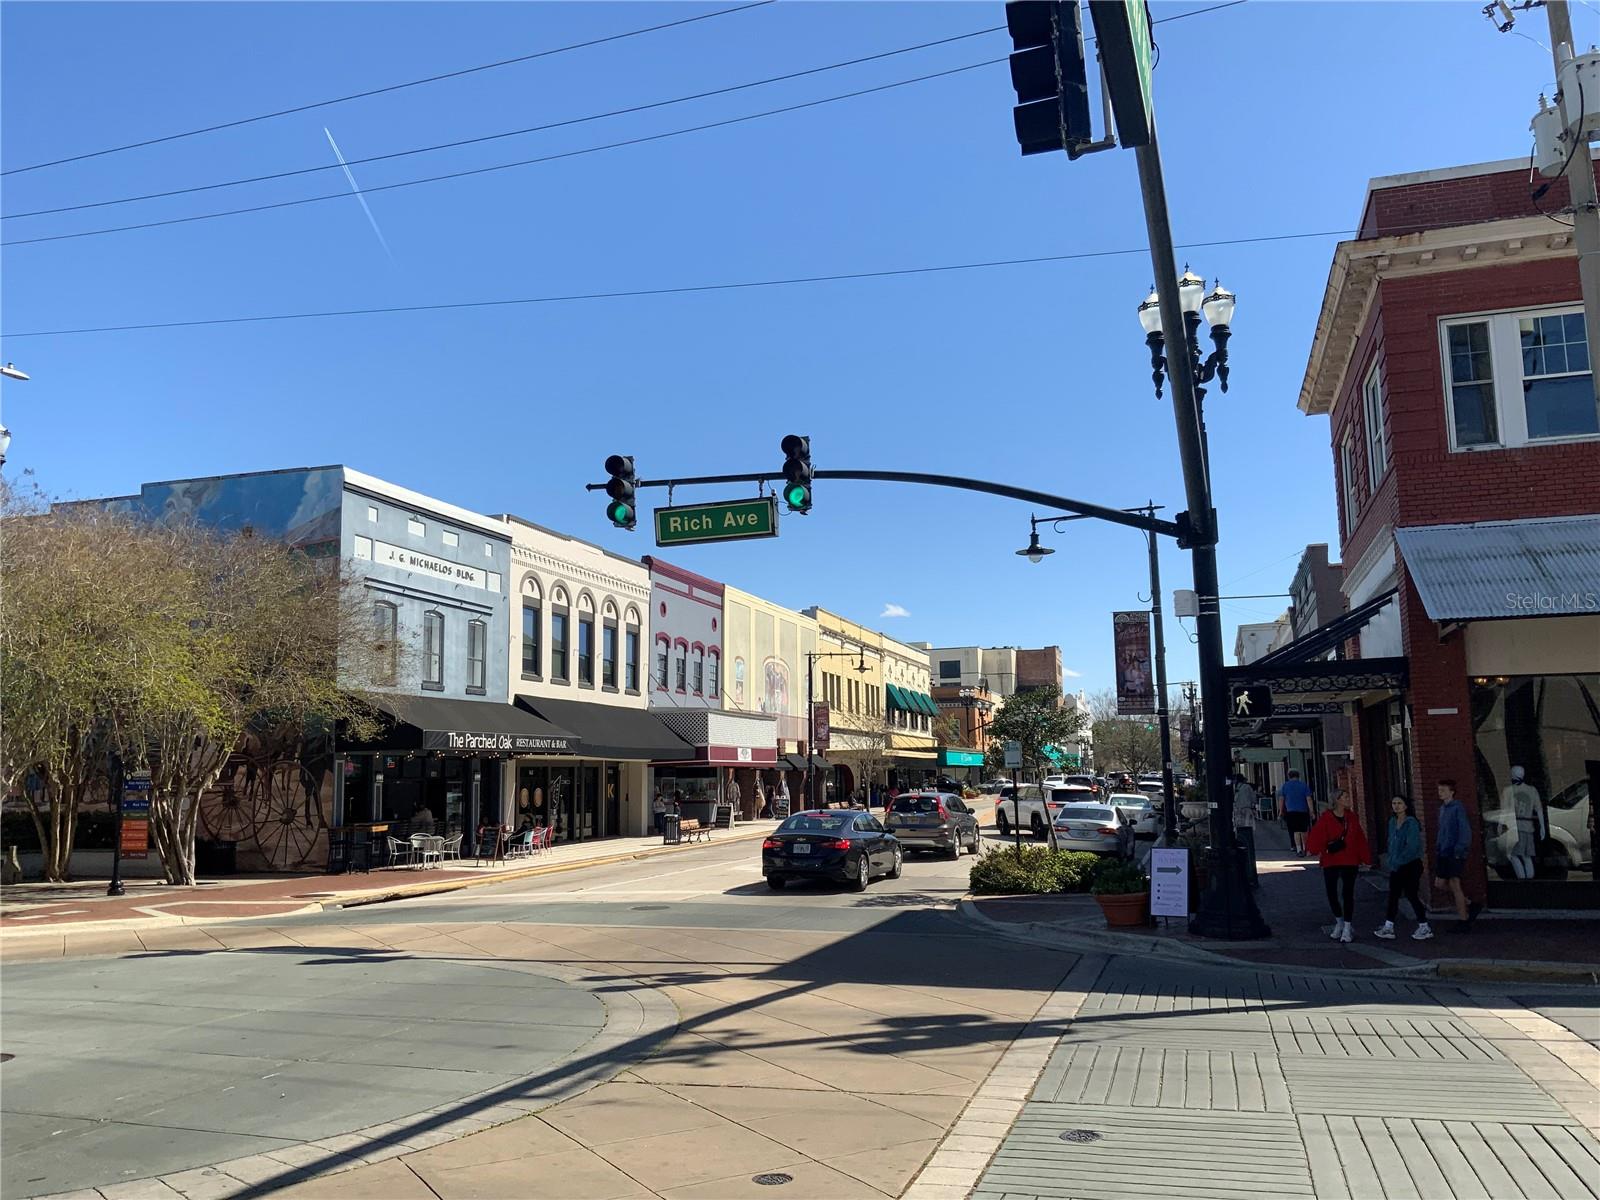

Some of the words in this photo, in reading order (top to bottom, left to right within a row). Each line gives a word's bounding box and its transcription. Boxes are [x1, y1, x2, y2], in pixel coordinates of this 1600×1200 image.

[669, 514, 712, 533] Rich
[723, 511, 758, 528] Ave
[410, 556, 452, 576] MICHAELOS
[447, 732, 464, 748] The
[465, 733, 497, 749] Parched
[498, 734, 513, 750] Oak
[516, 738, 551, 748] RESTAURANT
[551, 740, 556, 748] &
[556, 740, 567, 749] BAR
[607, 783, 615, 798] K
